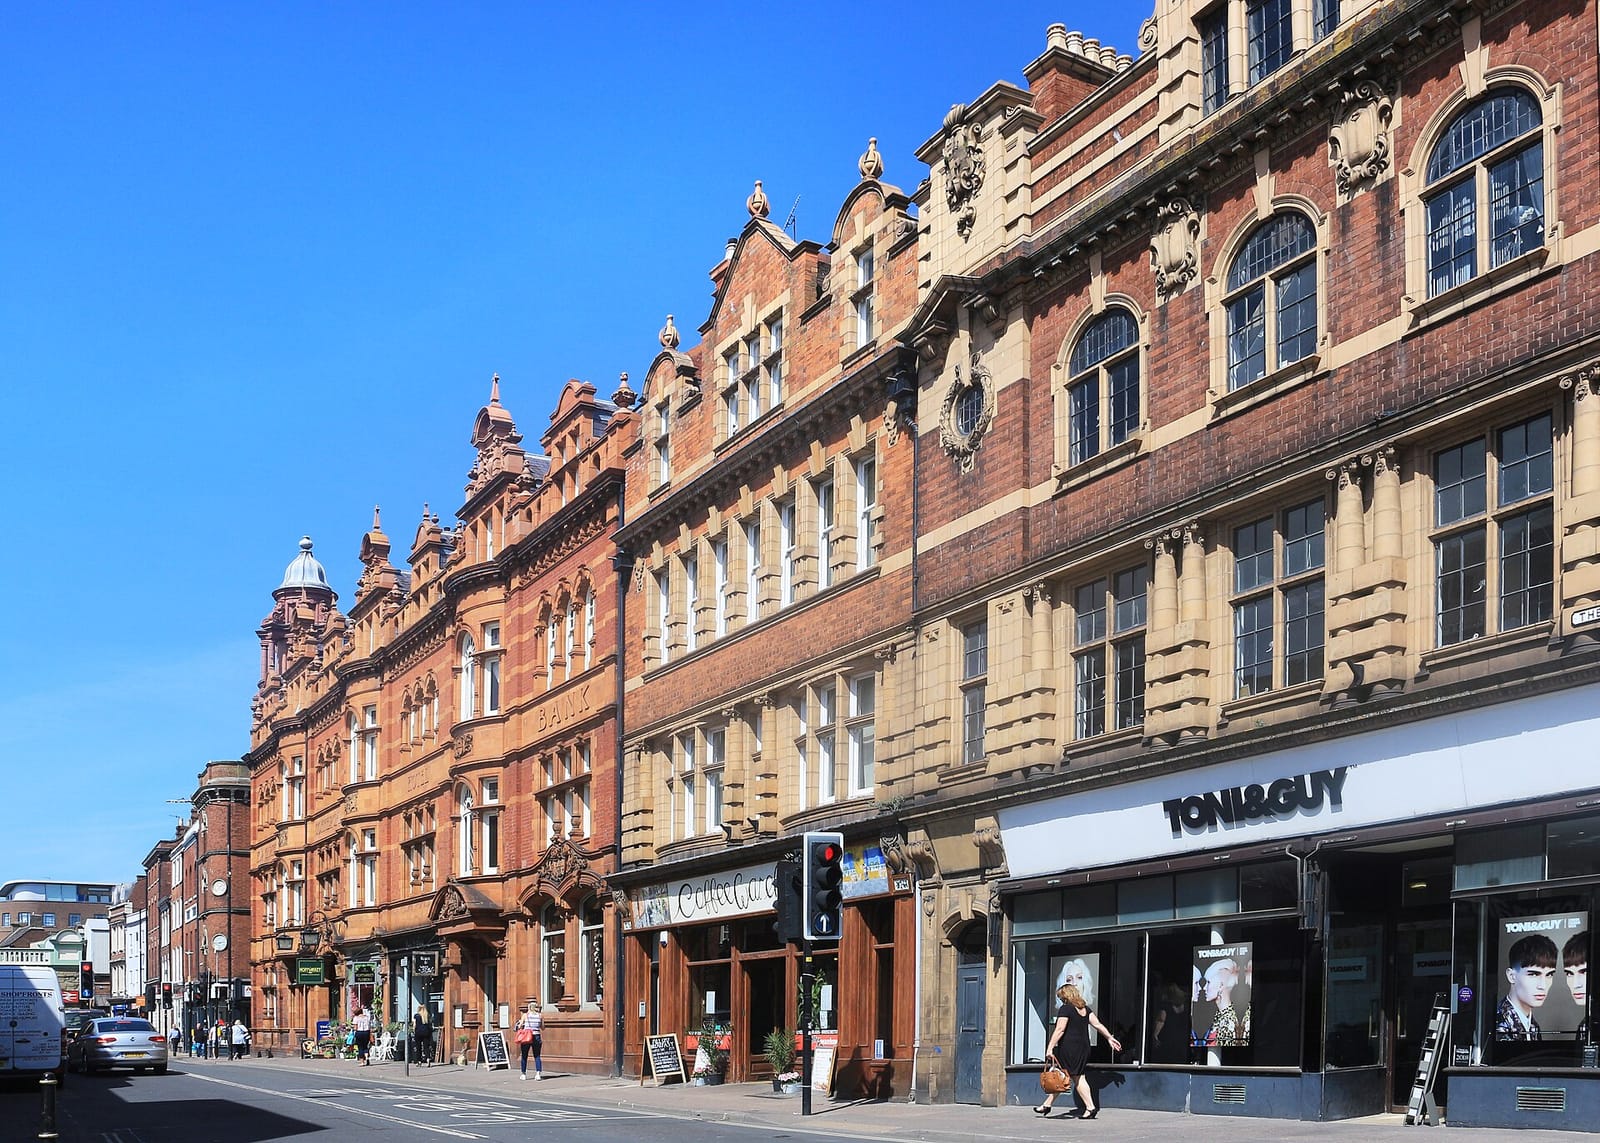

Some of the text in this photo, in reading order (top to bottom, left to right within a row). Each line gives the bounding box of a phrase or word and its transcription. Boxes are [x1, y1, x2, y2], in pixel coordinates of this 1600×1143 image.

[1579, 608, 1600, 621] THE
[538, 685, 590, 732] BANK
[1163, 766, 1348, 833] TONI&GUY
[674, 878, 734, 918] Coffee
[1505, 919, 1562, 933] TONI&GUY
[1198, 948, 1236, 958] TONI&GUY
[449, 1109, 604, 1122] BUS
